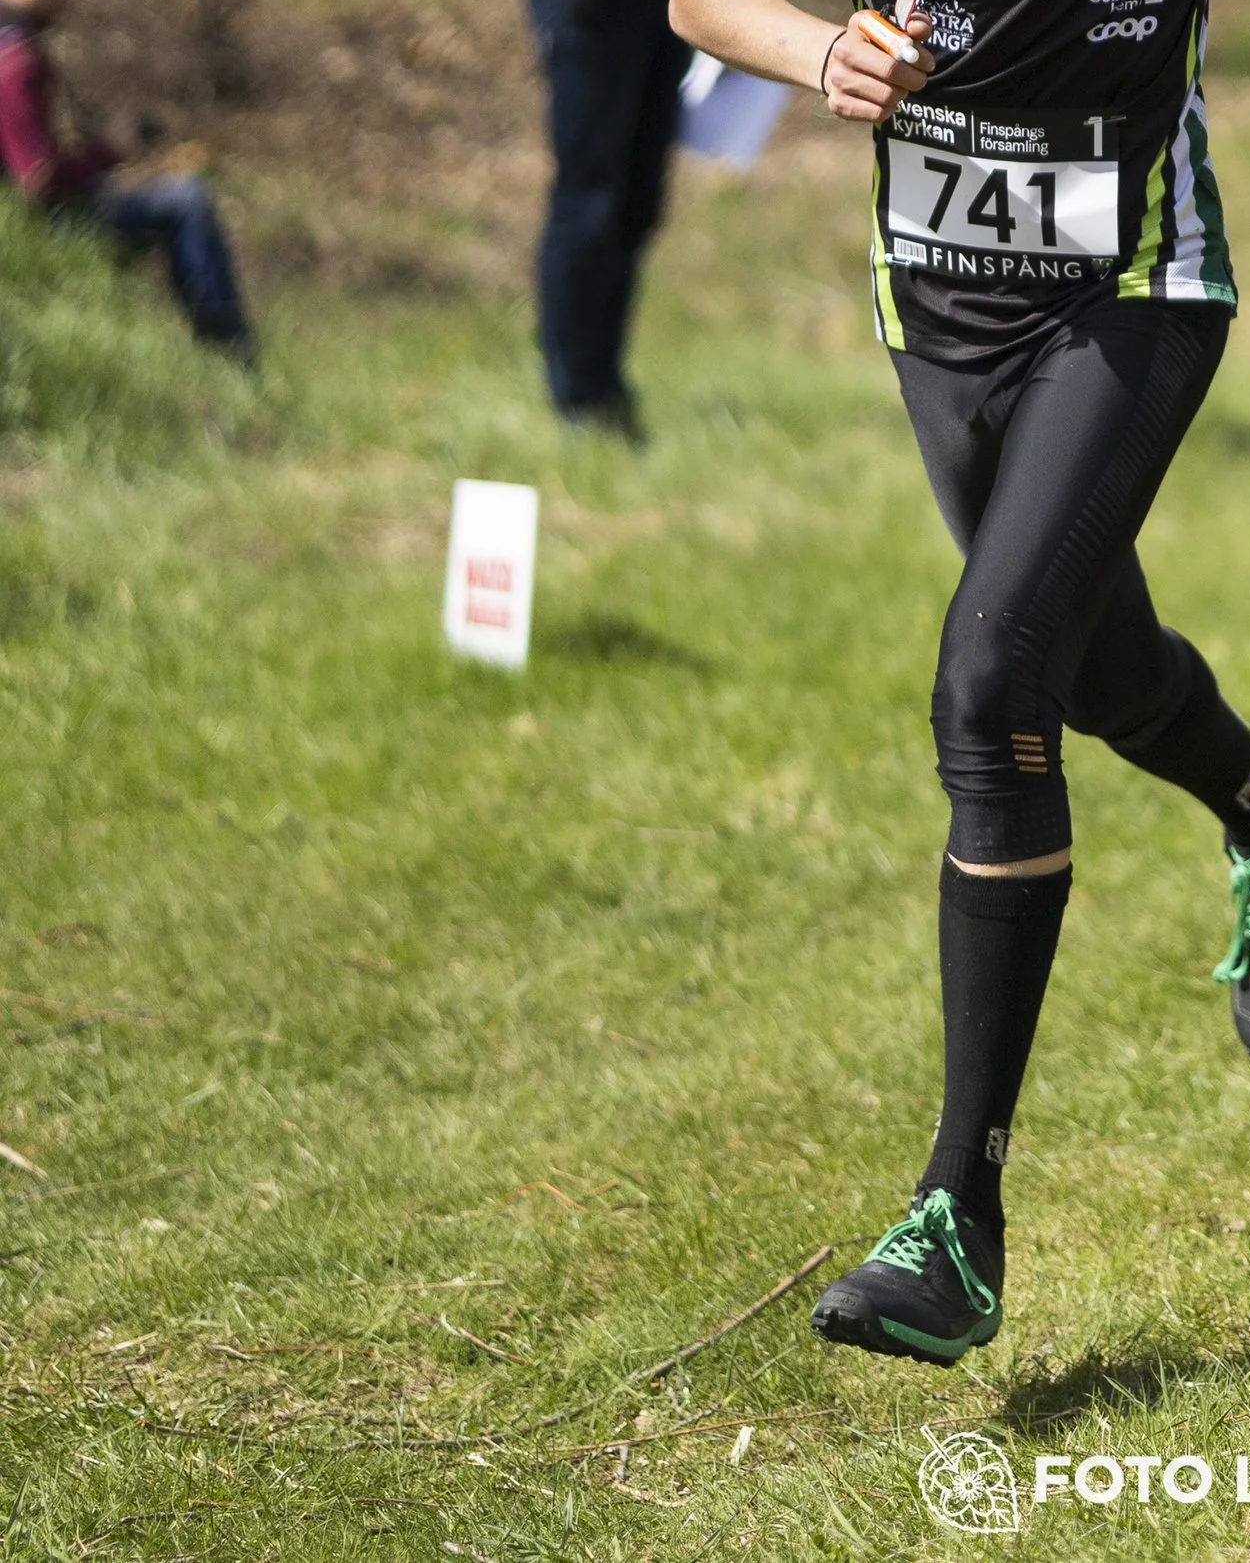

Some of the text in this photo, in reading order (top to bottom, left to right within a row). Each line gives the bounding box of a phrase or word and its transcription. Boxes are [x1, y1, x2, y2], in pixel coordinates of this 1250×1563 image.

[930, 11, 975, 34] STRA
[1086, 15, 1158, 42] coop
[892, 113, 955, 145] kyrkan
[980, 122, 1046, 139] Finspångs
[1088, 116, 1103, 157] 1
[980, 137, 1049, 156] församling
[924, 156, 1057, 247] 741
[932, 246, 1082, 279] FINSPÅNG
